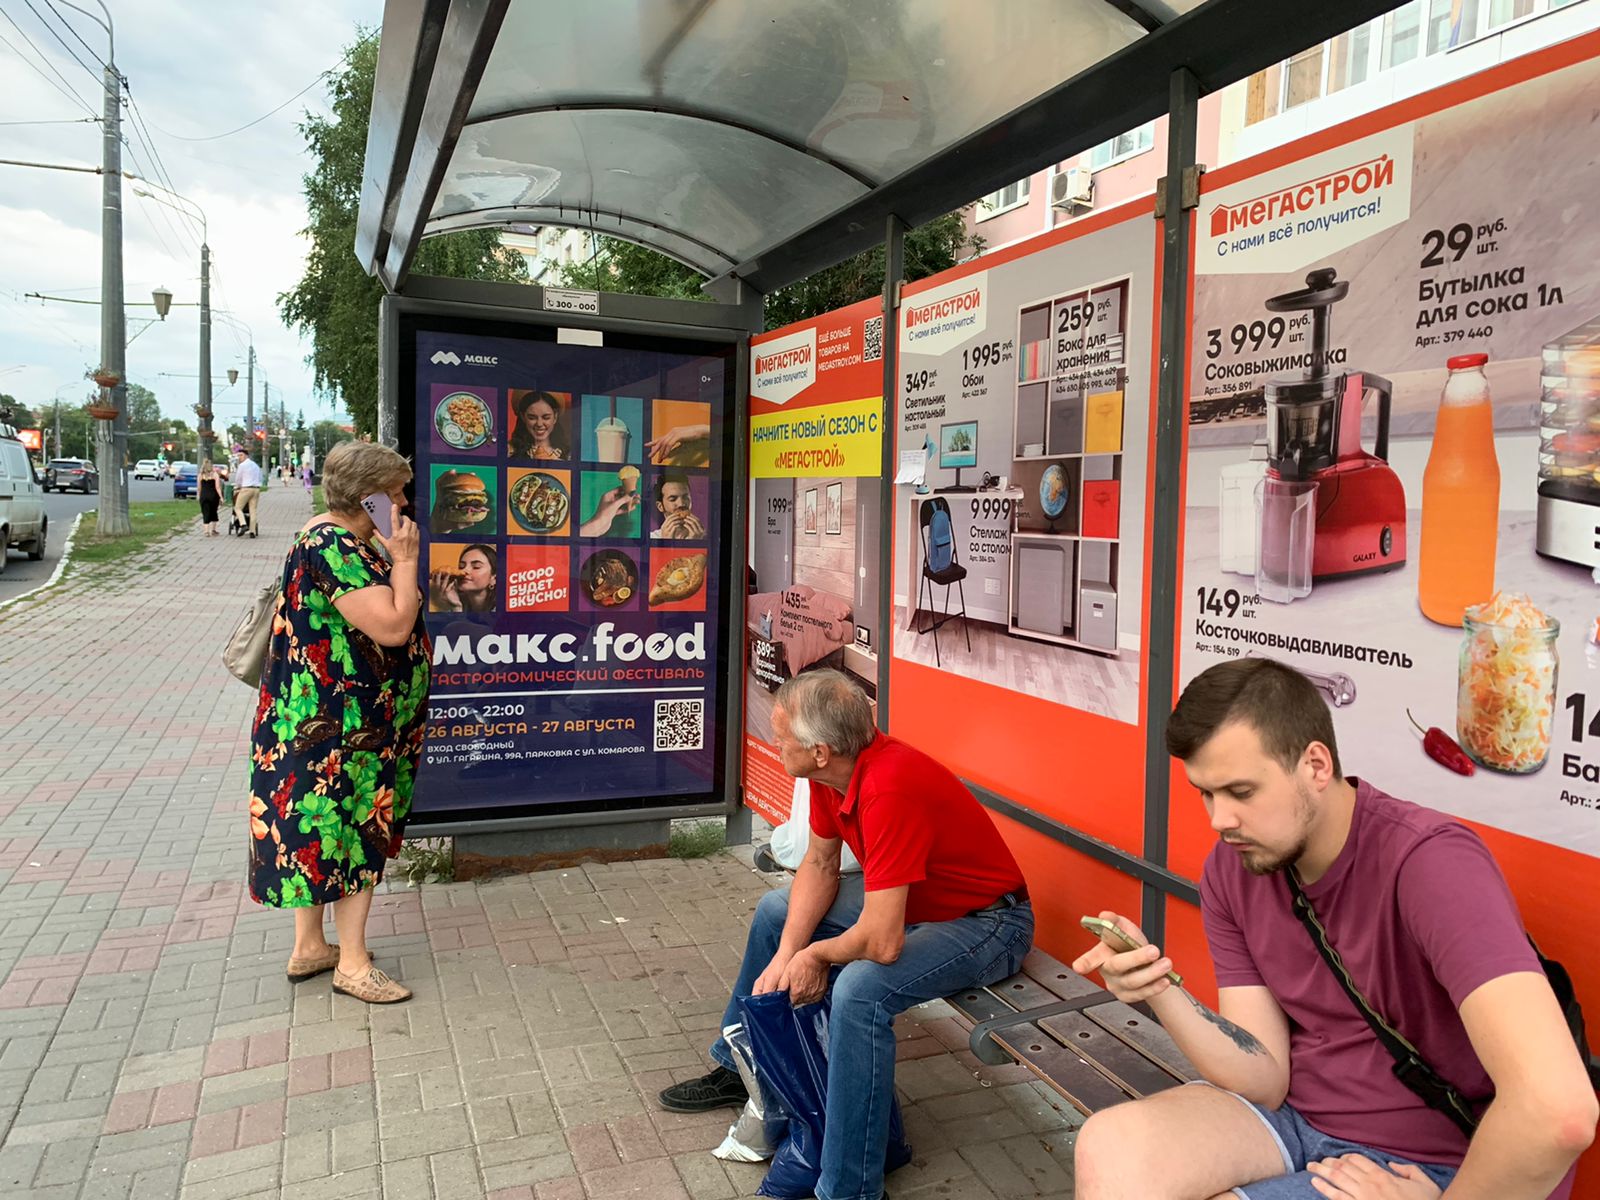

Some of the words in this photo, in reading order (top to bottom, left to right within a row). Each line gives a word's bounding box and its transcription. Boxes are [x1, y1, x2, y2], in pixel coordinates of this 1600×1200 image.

[1217, 241, 1228, 256] С
[1231, 233, 1265, 253] нами
[1269, 223, 1293, 243] всё
[1297, 196, 1381, 235] получится!
[1420, 222, 1474, 269] 29
[1477, 217, 1508, 239] руб.
[1476, 241, 1499, 254] шт.
[1418, 266, 1525, 303] Бутылка
[579, 303, 596, 311] 000
[1415, 304, 1458, 329] для
[1465, 292, 1529, 318] сока
[1537, 283, 1564, 308] 1л
[1058, 301, 1095, 333] 259
[1097, 298, 1112, 312] руб.
[1097, 313, 1108, 322] шт.
[908, 331, 914, 341] С
[915, 328, 929, 339] нами
[931, 323, 941, 335] всё
[942, 313, 976, 332] получится!
[1206, 329, 1222, 359] 3
[1231, 316, 1286, 355] 999
[1289, 313, 1311, 330] руб.
[1443, 330, 1465, 343] 379
[1468, 326, 1493, 339] 440
[1058, 338, 1084, 354] Бокс
[1086, 333, 1107, 350] для
[1289, 332, 1304, 343] шт.
[819, 344, 841, 357] ТОВАРОВ
[842, 342, 850, 352] НА
[962, 349, 968, 371] 1
[972, 342, 1000, 369] 995
[464, 354, 499, 365] макс
[1056, 350, 1110, 372] хранения
[1205, 348, 1347, 381] Соковыжималка
[905, 370, 928, 393] 349
[962, 374, 984, 388] Обои
[1222, 382, 1237, 393] 356
[1238, 380, 1252, 391] 891
[905, 394, 946, 409] Светильник
[905, 405, 946, 422] настольный
[753, 424, 789, 443] НАЧНИТЕ
[792, 414, 826, 439] НОВЫЙ
[829, 415, 866, 435] СЕЗОН
[868, 413, 878, 432] С
[775, 443, 845, 469] «МЕГАСТРОЙ»
[772, 497, 787, 513] 999
[971, 498, 980, 519] 9
[982, 498, 1011, 520] 999
[970, 525, 1007, 539] Стеллаж
[970, 542, 979, 552] со
[981, 543, 1012, 554] столом
[1352, 552, 1376, 563] GALAXY
[509, 566, 555, 584] СКОРО
[509, 578, 554, 597] БУДЕТ
[509, 587, 567, 608] ВКУСНО!
[785, 591, 801, 609] 435
[1197, 586, 1241, 618] 149
[1242, 594, 1262, 606] руб.
[1242, 609, 1257, 619] шт.
[757, 640, 770, 658] 389
[1196, 618, 1413, 670] Косточковыдавливатель
[1213, 645, 1226, 654] 154
[1227, 646, 1240, 657] 519
[431, 666, 608, 686] ГАСТРОНОМИЧЕСКИЙ
[612, 668, 705, 681] ФЕСТИВАЛЬ
[428, 706, 468, 720] 12:00
[483, 704, 525, 717] 22:00
[427, 726, 447, 739] 26
[451, 722, 528, 737] АВГУСТА
[542, 721, 560, 733] 27
[564, 718, 636, 732] АВГУСТА
[427, 744, 454, 754] ВХОД
[455, 740, 515, 752] СВОБОДНЫЙ
[525, 750, 572, 759] ПАРКОВКА
[598, 745, 645, 755] КОМАРОВА
